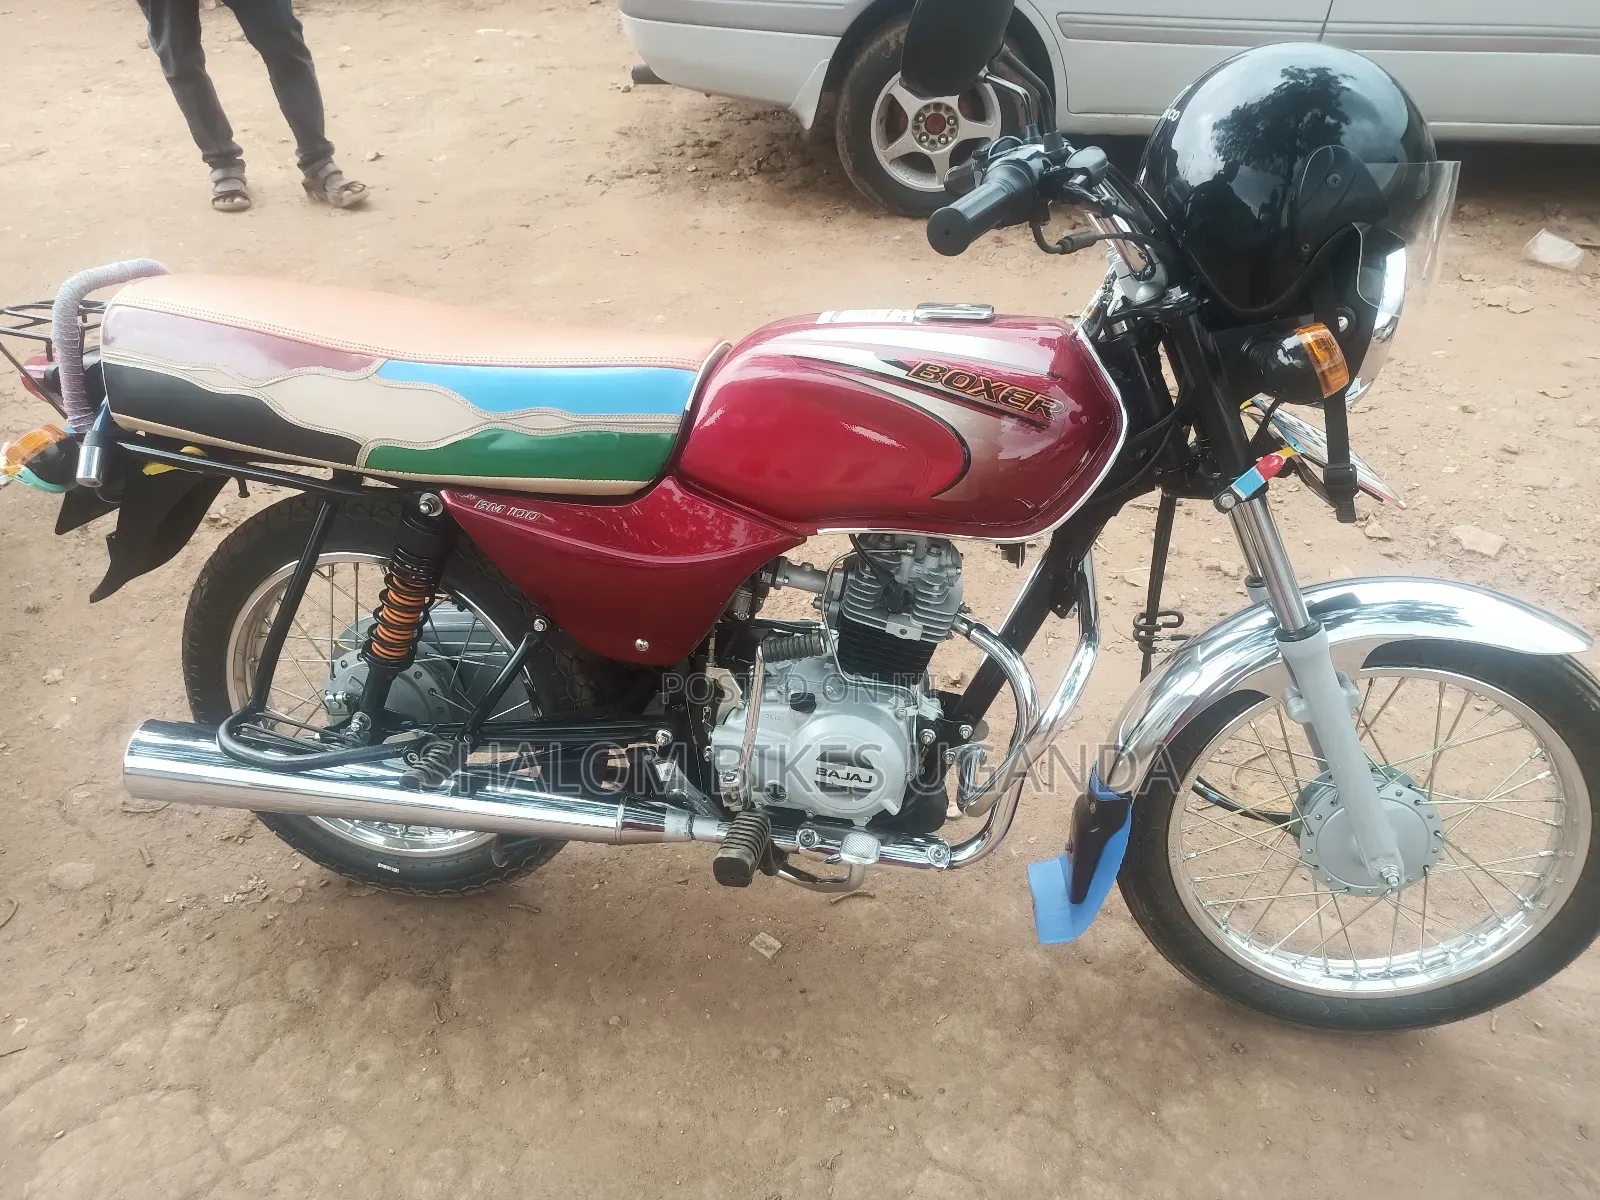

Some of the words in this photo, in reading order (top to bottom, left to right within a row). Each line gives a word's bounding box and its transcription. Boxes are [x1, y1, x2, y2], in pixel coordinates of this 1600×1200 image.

[907, 360, 1067, 422] BOXER
[473, 499, 507, 514] BM
[507, 506, 541, 521] 100
[815, 766, 873, 784] BAJAJ
